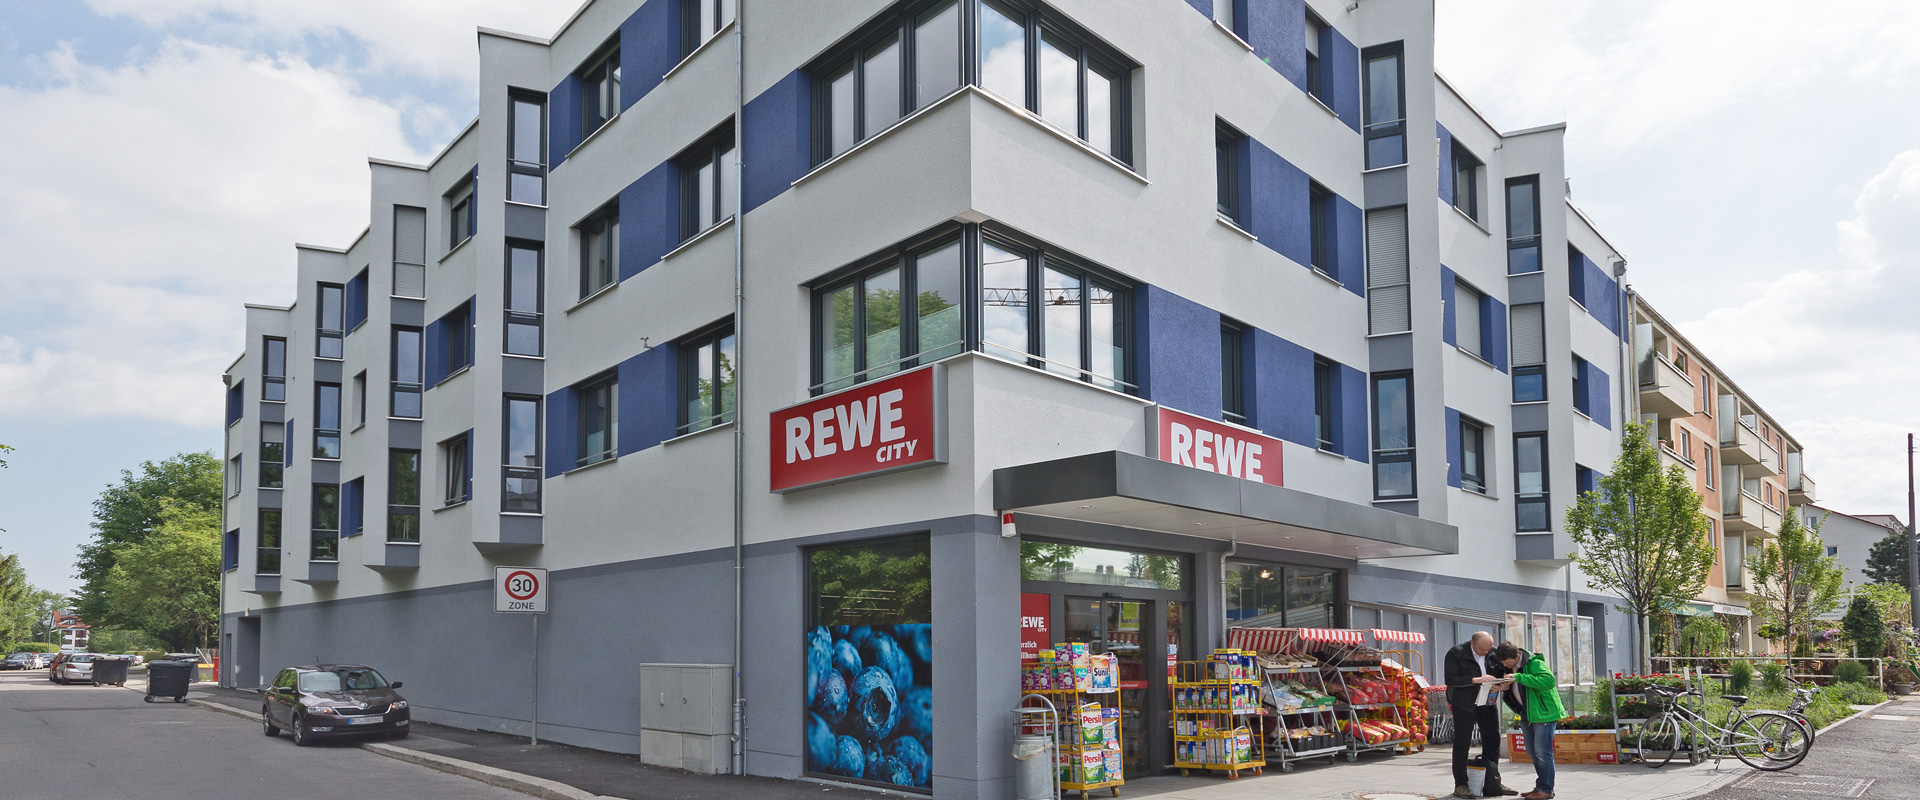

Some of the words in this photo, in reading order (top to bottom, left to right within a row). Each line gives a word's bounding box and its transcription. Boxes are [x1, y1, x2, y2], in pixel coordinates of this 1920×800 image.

[785, 388, 906, 464] REWE
[875, 439, 918, 463] CITY
[1170, 421, 1264, 484] REWE
[511, 578, 532, 592] 30
[508, 601, 535, 610] ZONE
[1021, 616, 1045, 628] EWE
[1093, 667, 1109, 677] Sunil
[1082, 714, 1102, 724] Persil
[1236, 738, 1250, 746] Persil
[1083, 754, 1102, 764] Persil
